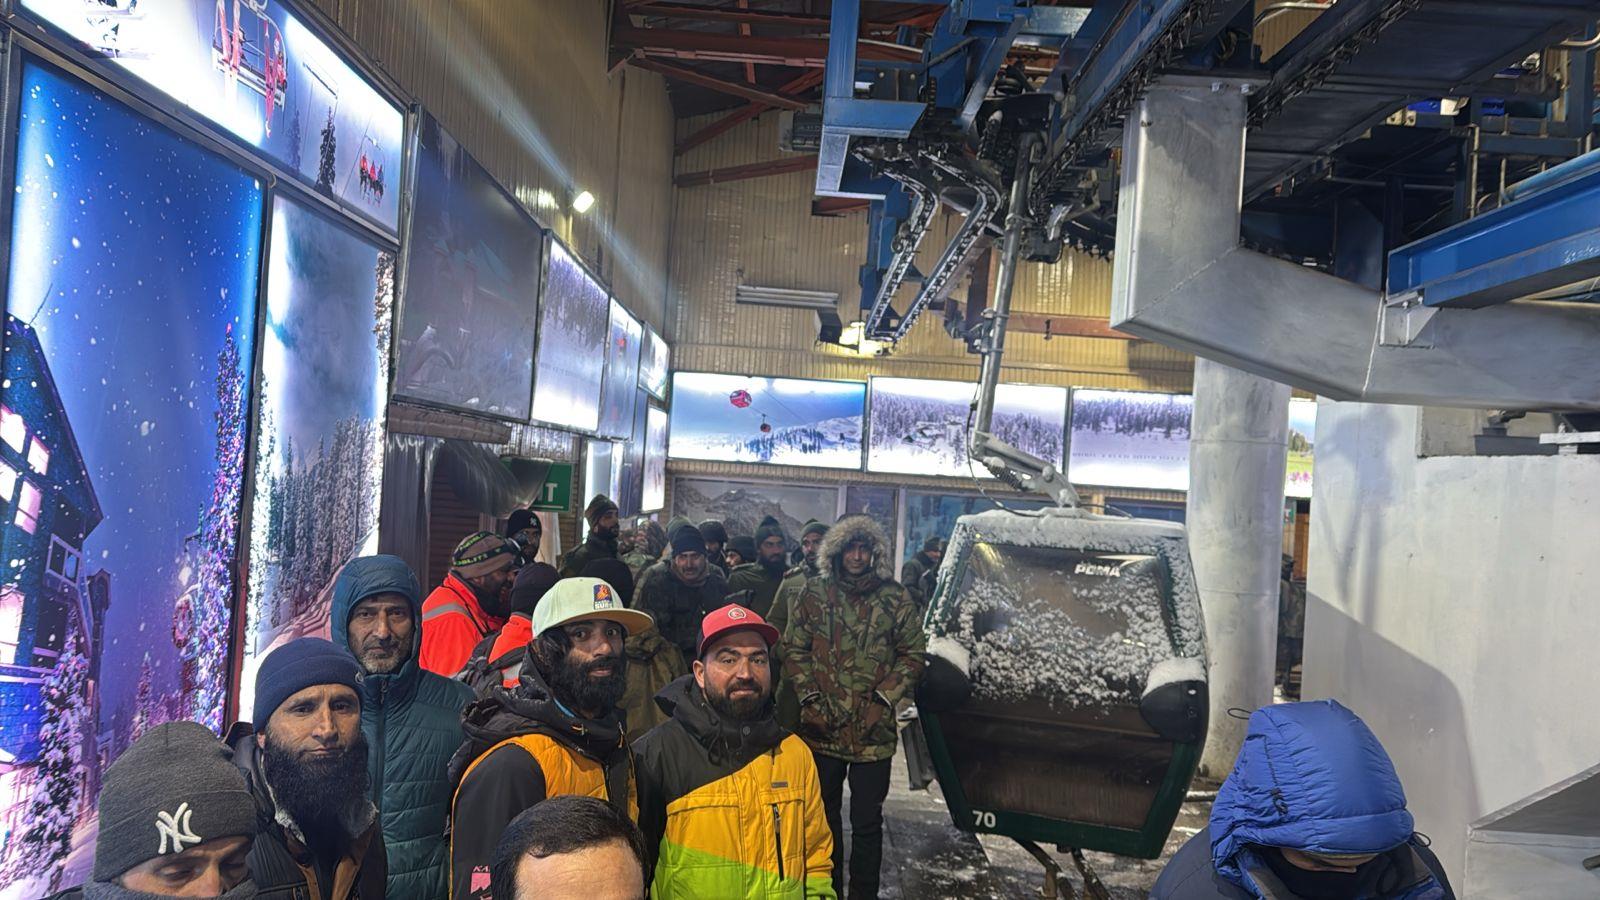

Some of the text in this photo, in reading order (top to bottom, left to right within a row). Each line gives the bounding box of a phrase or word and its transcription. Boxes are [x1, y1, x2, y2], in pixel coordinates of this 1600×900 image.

[1074, 563, 1121, 577] POMA
[972, 809, 996, 828] 70
[155, 802, 202, 855] NY
